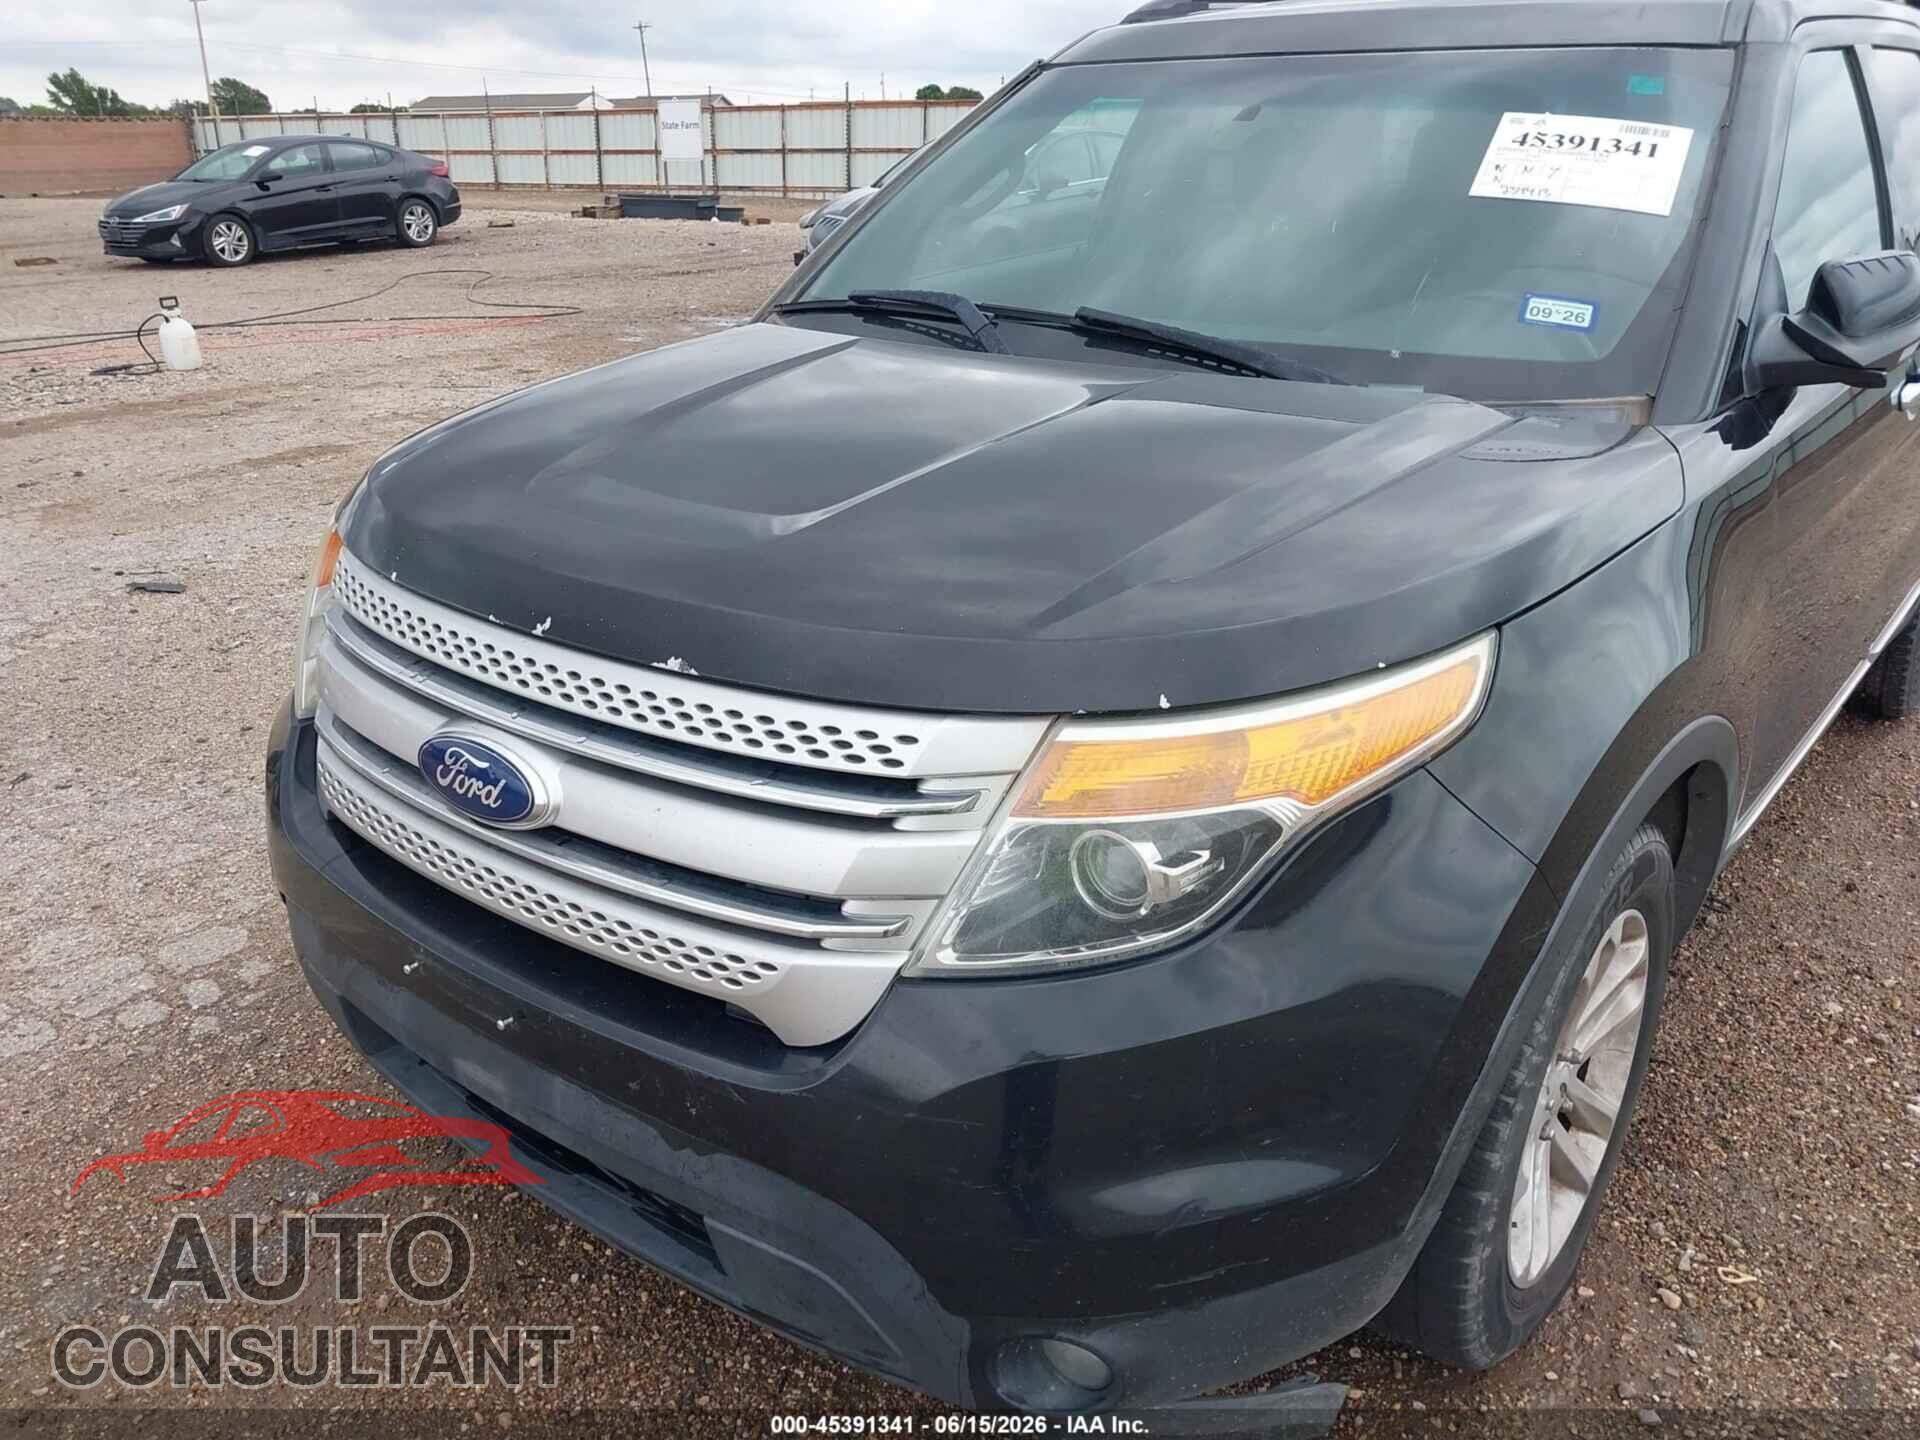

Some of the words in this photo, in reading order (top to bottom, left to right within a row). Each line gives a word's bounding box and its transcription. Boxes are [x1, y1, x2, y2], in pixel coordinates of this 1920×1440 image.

[662, 121, 680, 129] State
[681, 121, 700, 129] Farm
[1511, 131, 1660, 158] 45391341
[1529, 305, 1553, 319] 09
[1562, 310, 1586, 324] 26
[436, 747, 506, 808] Ford
